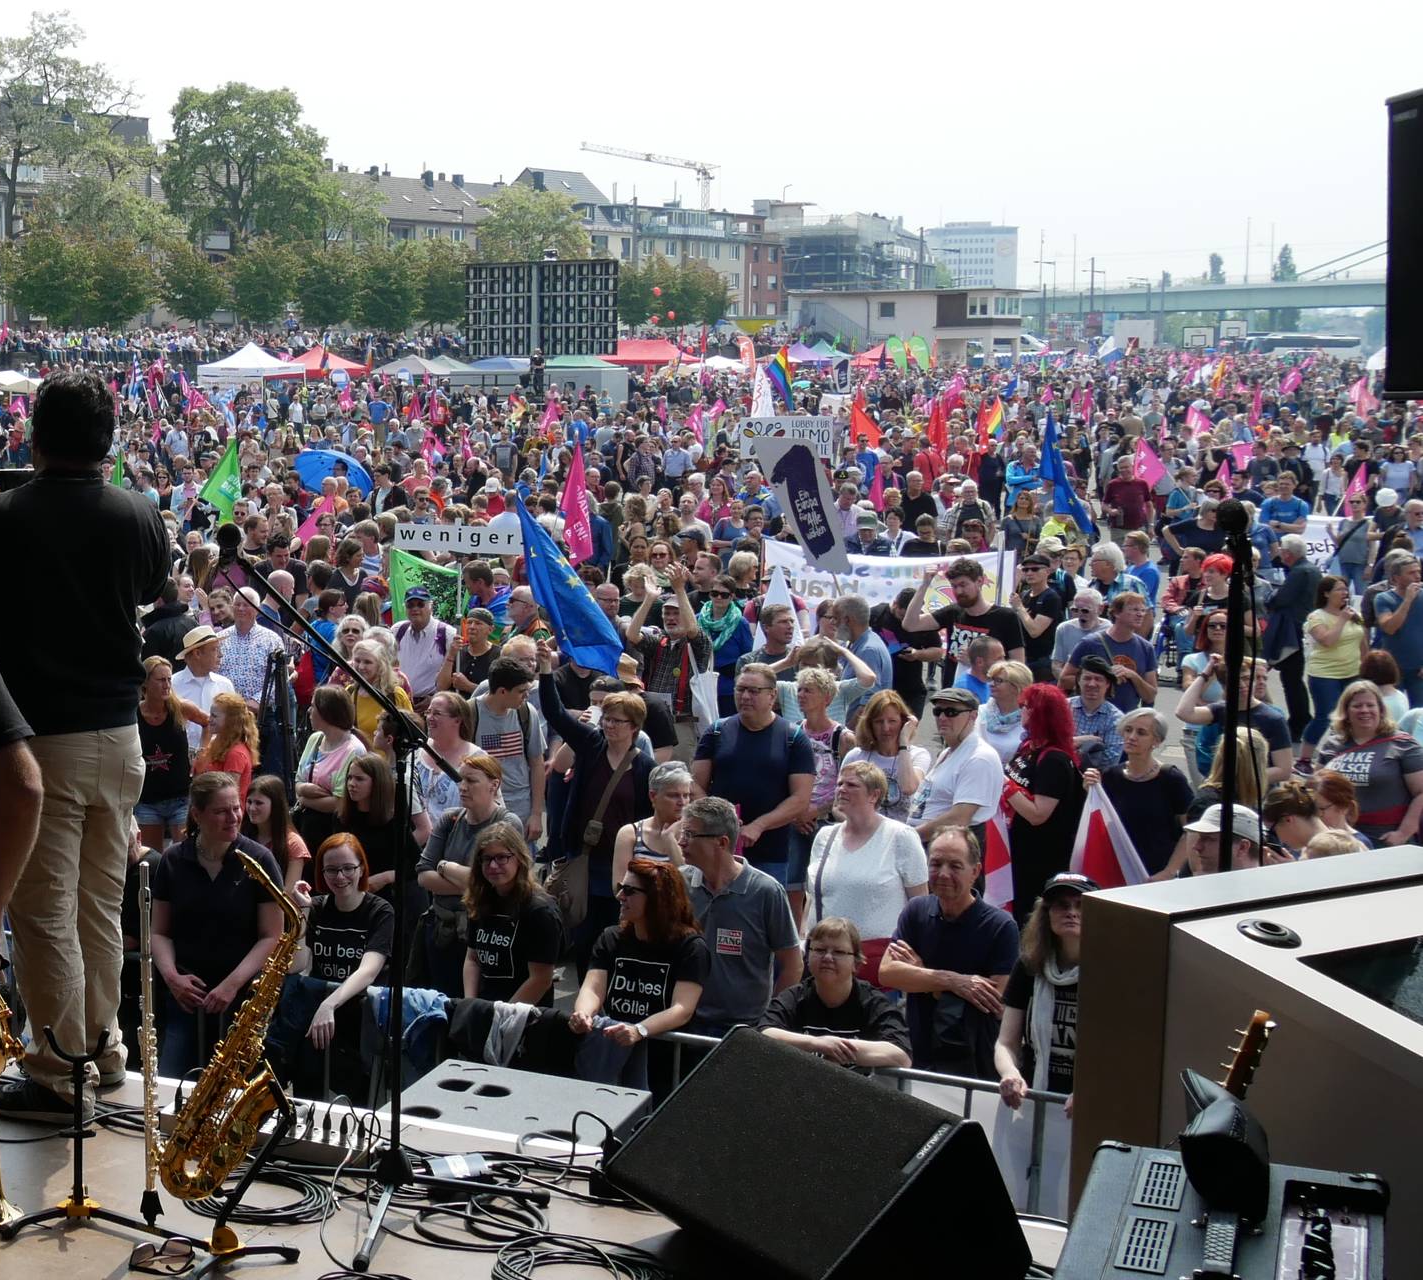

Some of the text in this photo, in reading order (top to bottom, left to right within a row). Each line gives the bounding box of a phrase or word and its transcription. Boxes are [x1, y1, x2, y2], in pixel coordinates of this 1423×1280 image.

[1342, 752, 1376, 763] AKE
[476, 928, 511, 947] Du bes
[313, 942, 332, 957] Du
[319, 964, 352, 980] ölle!
[614, 975, 662, 996] Du bes
[610, 996, 650, 1017] Kölle!
